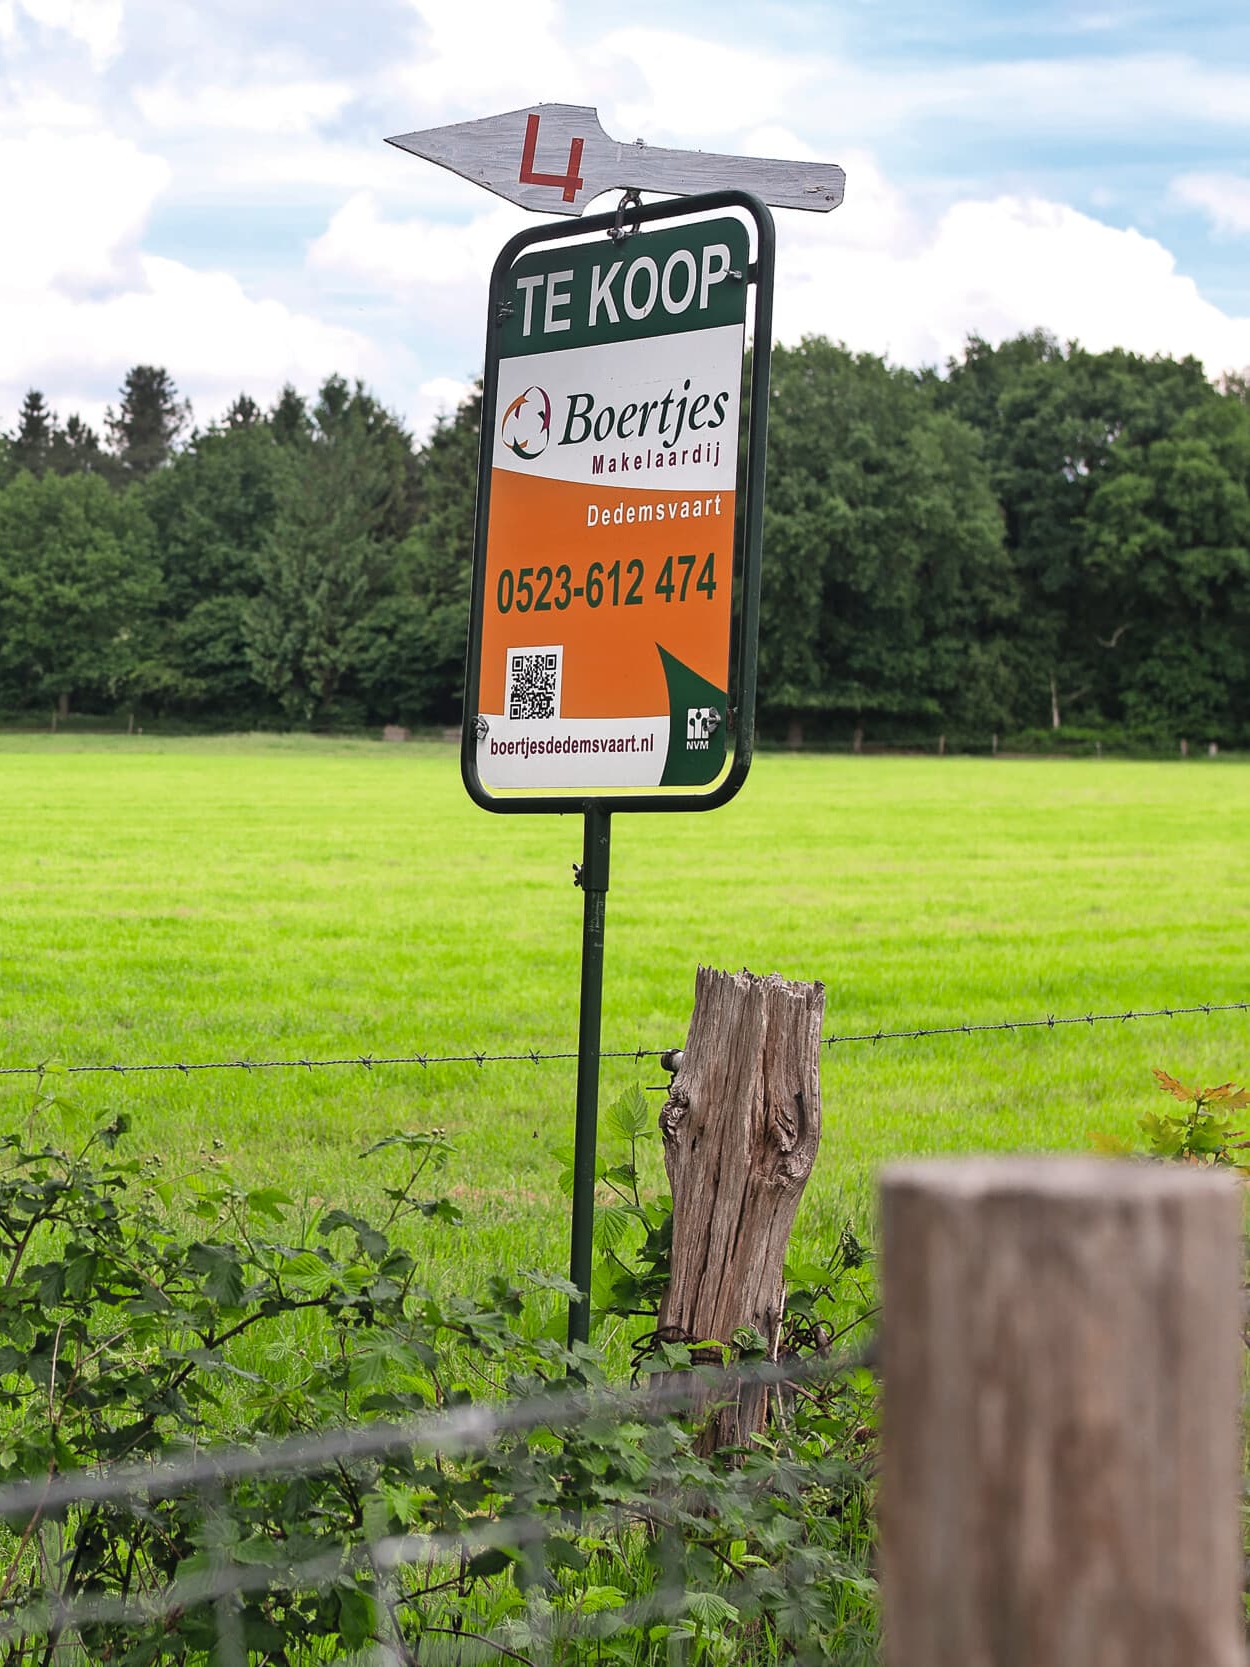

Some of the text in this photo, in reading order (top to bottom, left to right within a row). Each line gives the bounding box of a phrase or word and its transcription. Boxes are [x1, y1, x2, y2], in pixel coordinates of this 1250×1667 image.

[519, 114, 584, 203] 4
[516, 243, 731, 337] TE KOOP
[558, 379, 729, 449] Boertjes
[592, 441, 721, 475] Makelaardij
[586, 494, 721, 527] Dedemsvaart
[497, 552, 717, 614] 0523-612 474
[490, 733, 654, 759] boertjesdedemsvaart.nl
[686, 740, 709, 750] NVM
